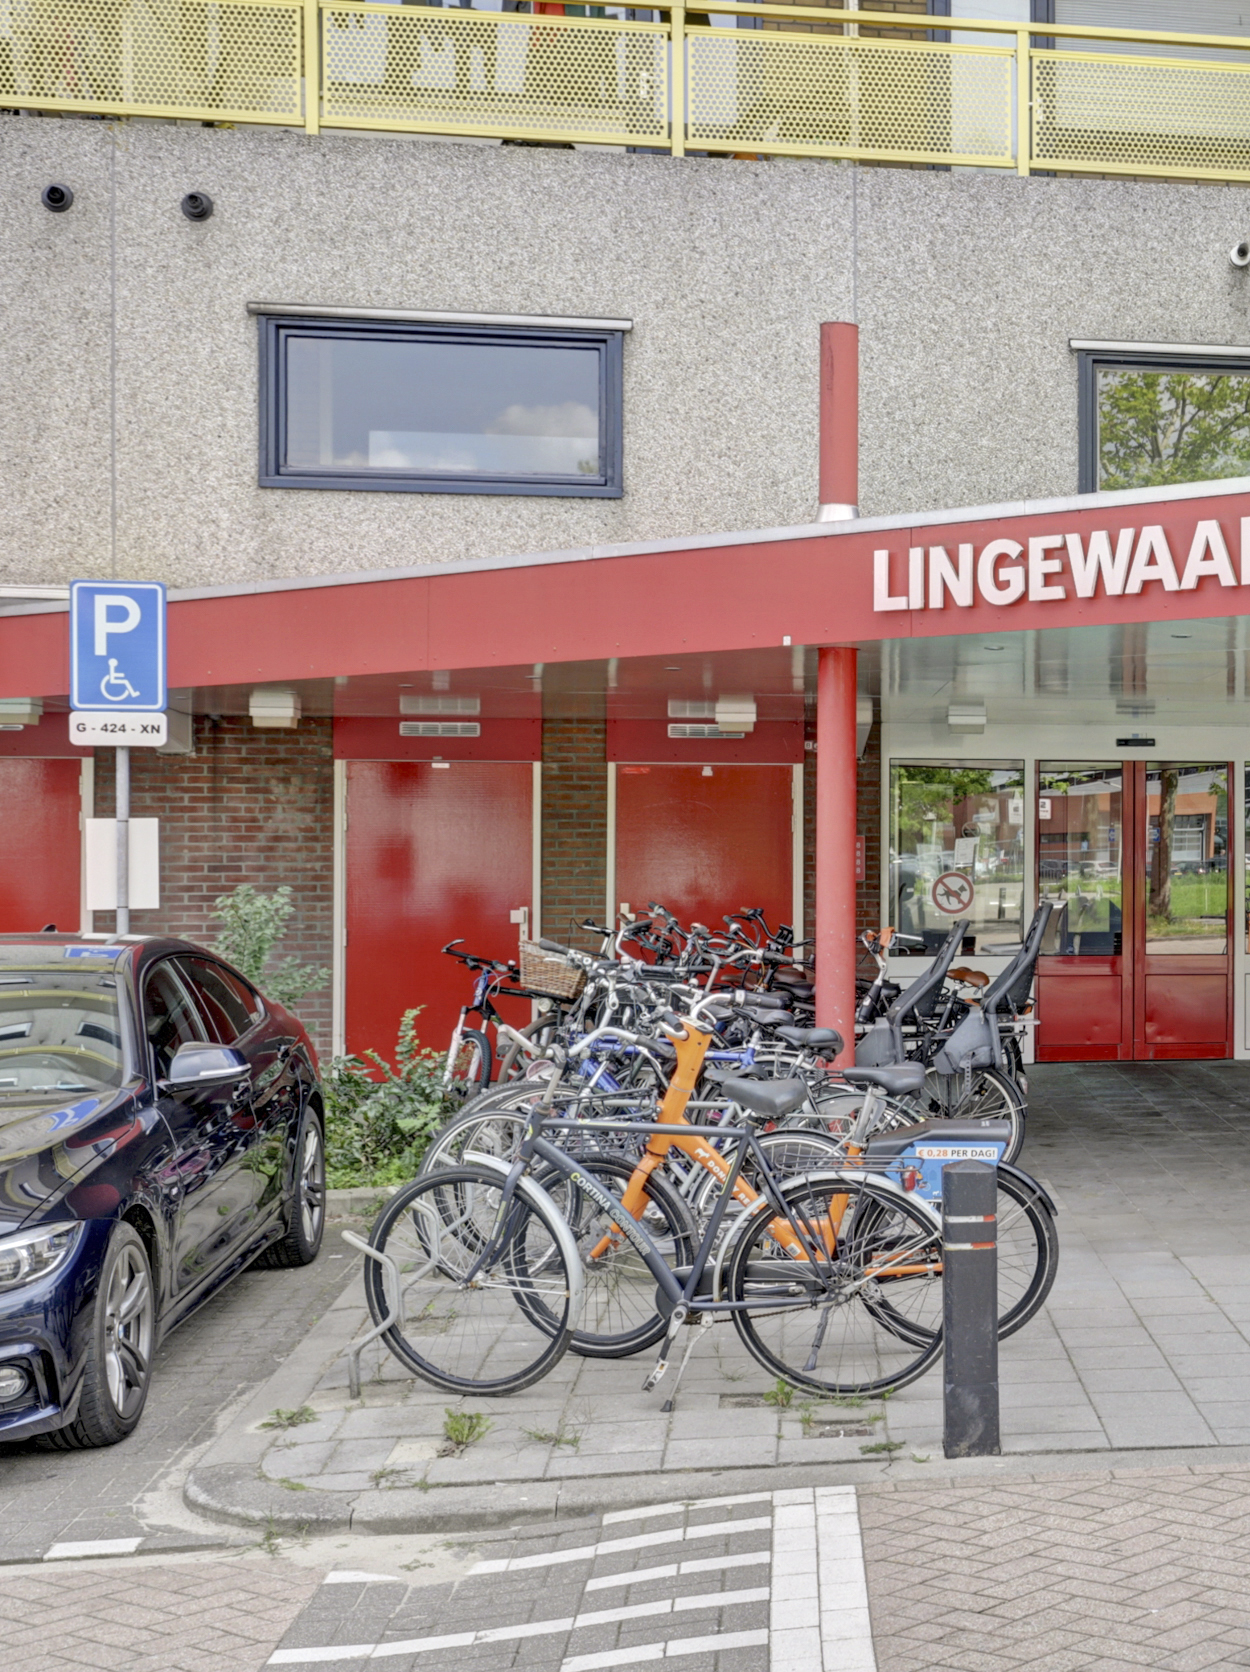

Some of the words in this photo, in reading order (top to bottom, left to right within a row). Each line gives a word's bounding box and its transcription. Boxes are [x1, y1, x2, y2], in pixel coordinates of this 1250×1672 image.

[94, 594, 141, 656] P
[100, 723, 127, 734] 424
[927, 1149, 949, 1158] 0,28
[951, 1149, 969, 1158] PER
[971, 1149, 996, 1158] DAG!
[570, 1172, 612, 1211] CORTINA
